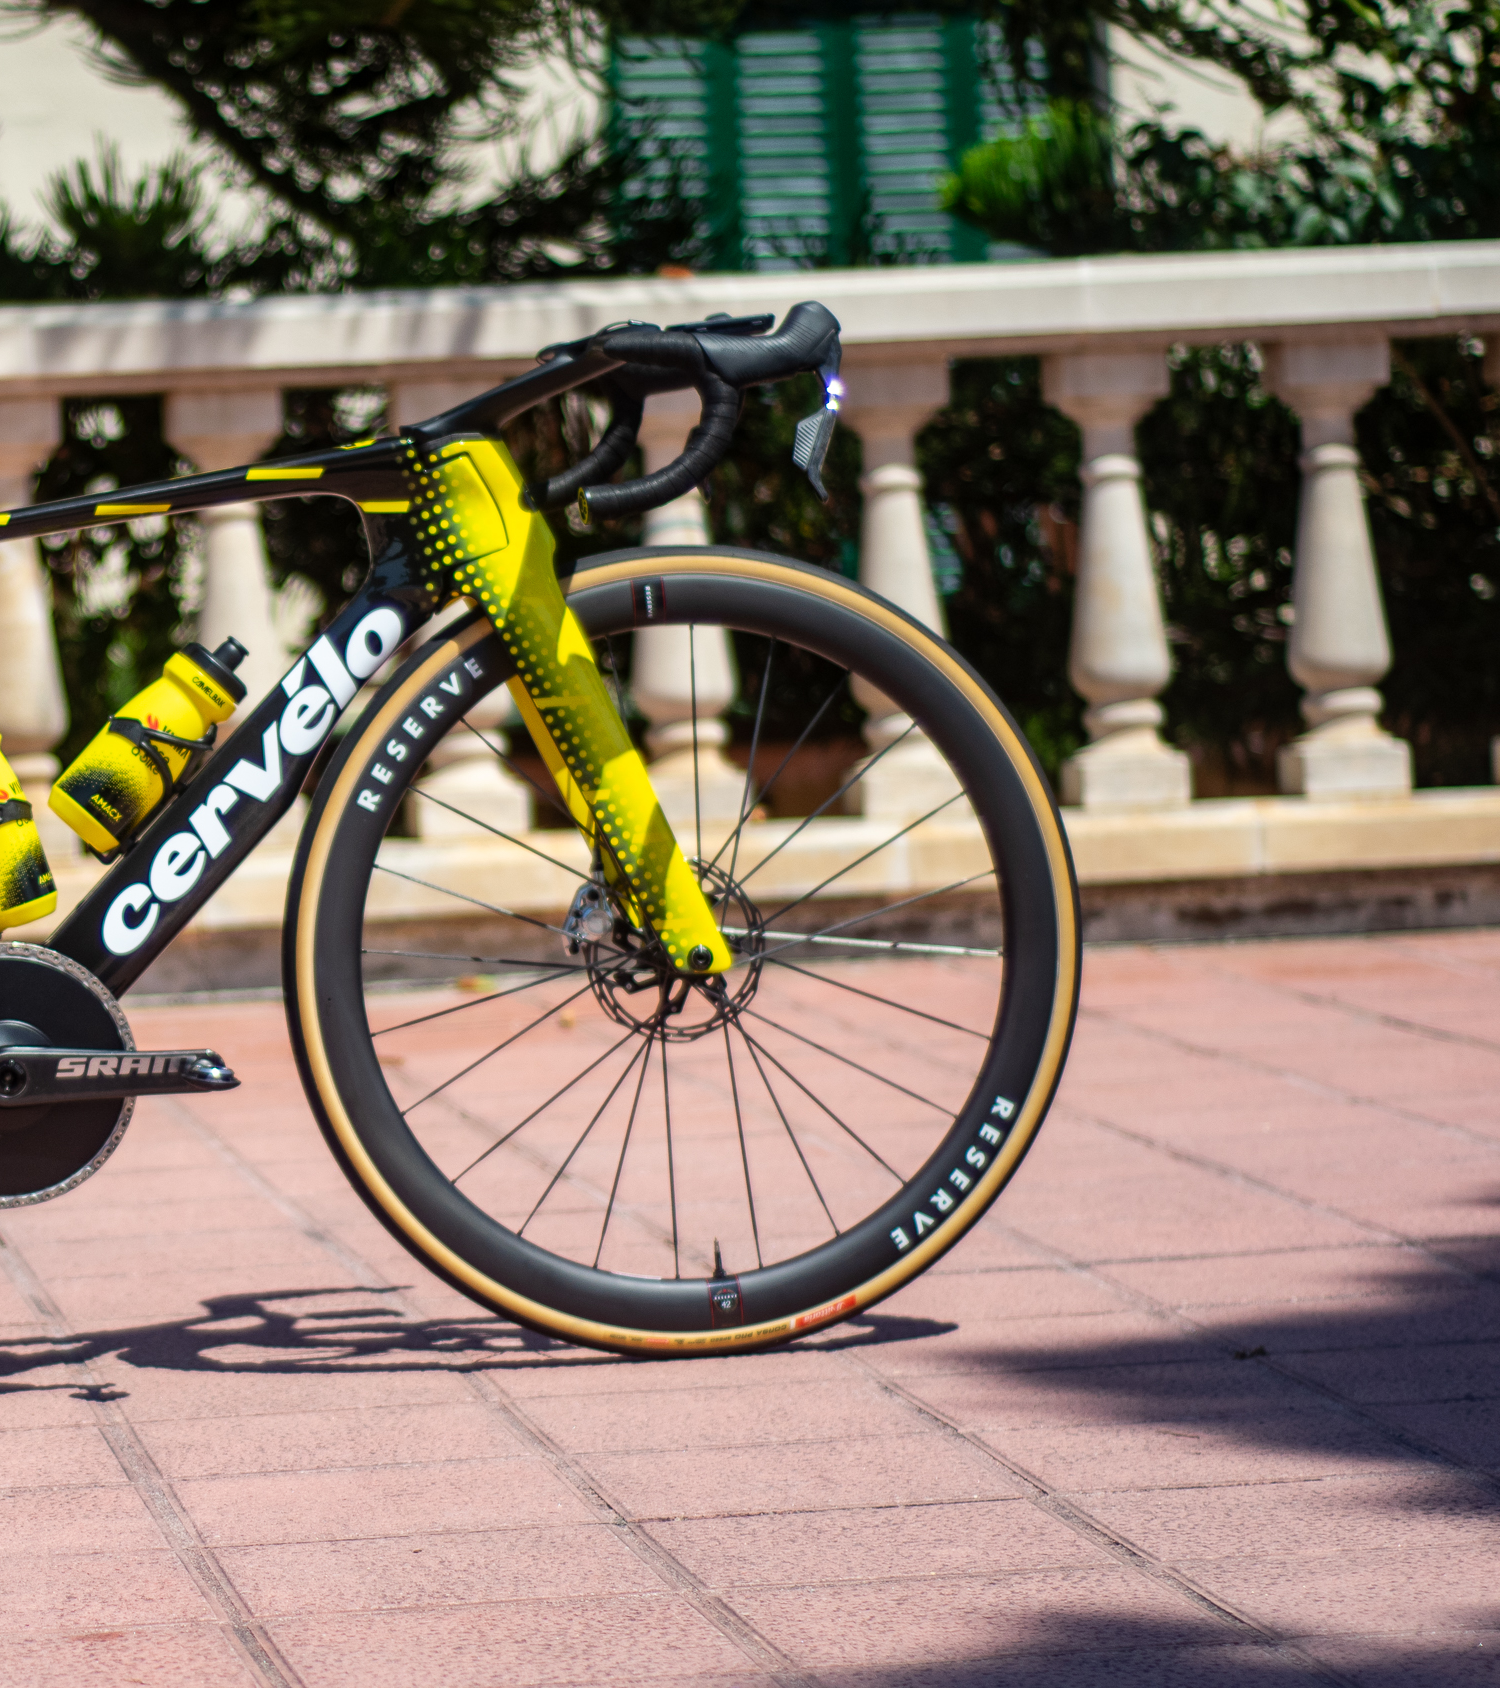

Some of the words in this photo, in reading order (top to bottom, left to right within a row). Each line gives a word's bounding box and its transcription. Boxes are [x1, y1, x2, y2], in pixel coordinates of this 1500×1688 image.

[192, 676, 225, 708] CAMELBAK
[356, 657, 483, 812] RESERVE
[101, 606, 402, 956] cervélo
[90, 793, 123, 823] AMACX
[889, 1095, 1015, 1250] RESERVE
[721, 1300, 732, 1309] 42
[804, 1305, 836, 1323] vittoria
